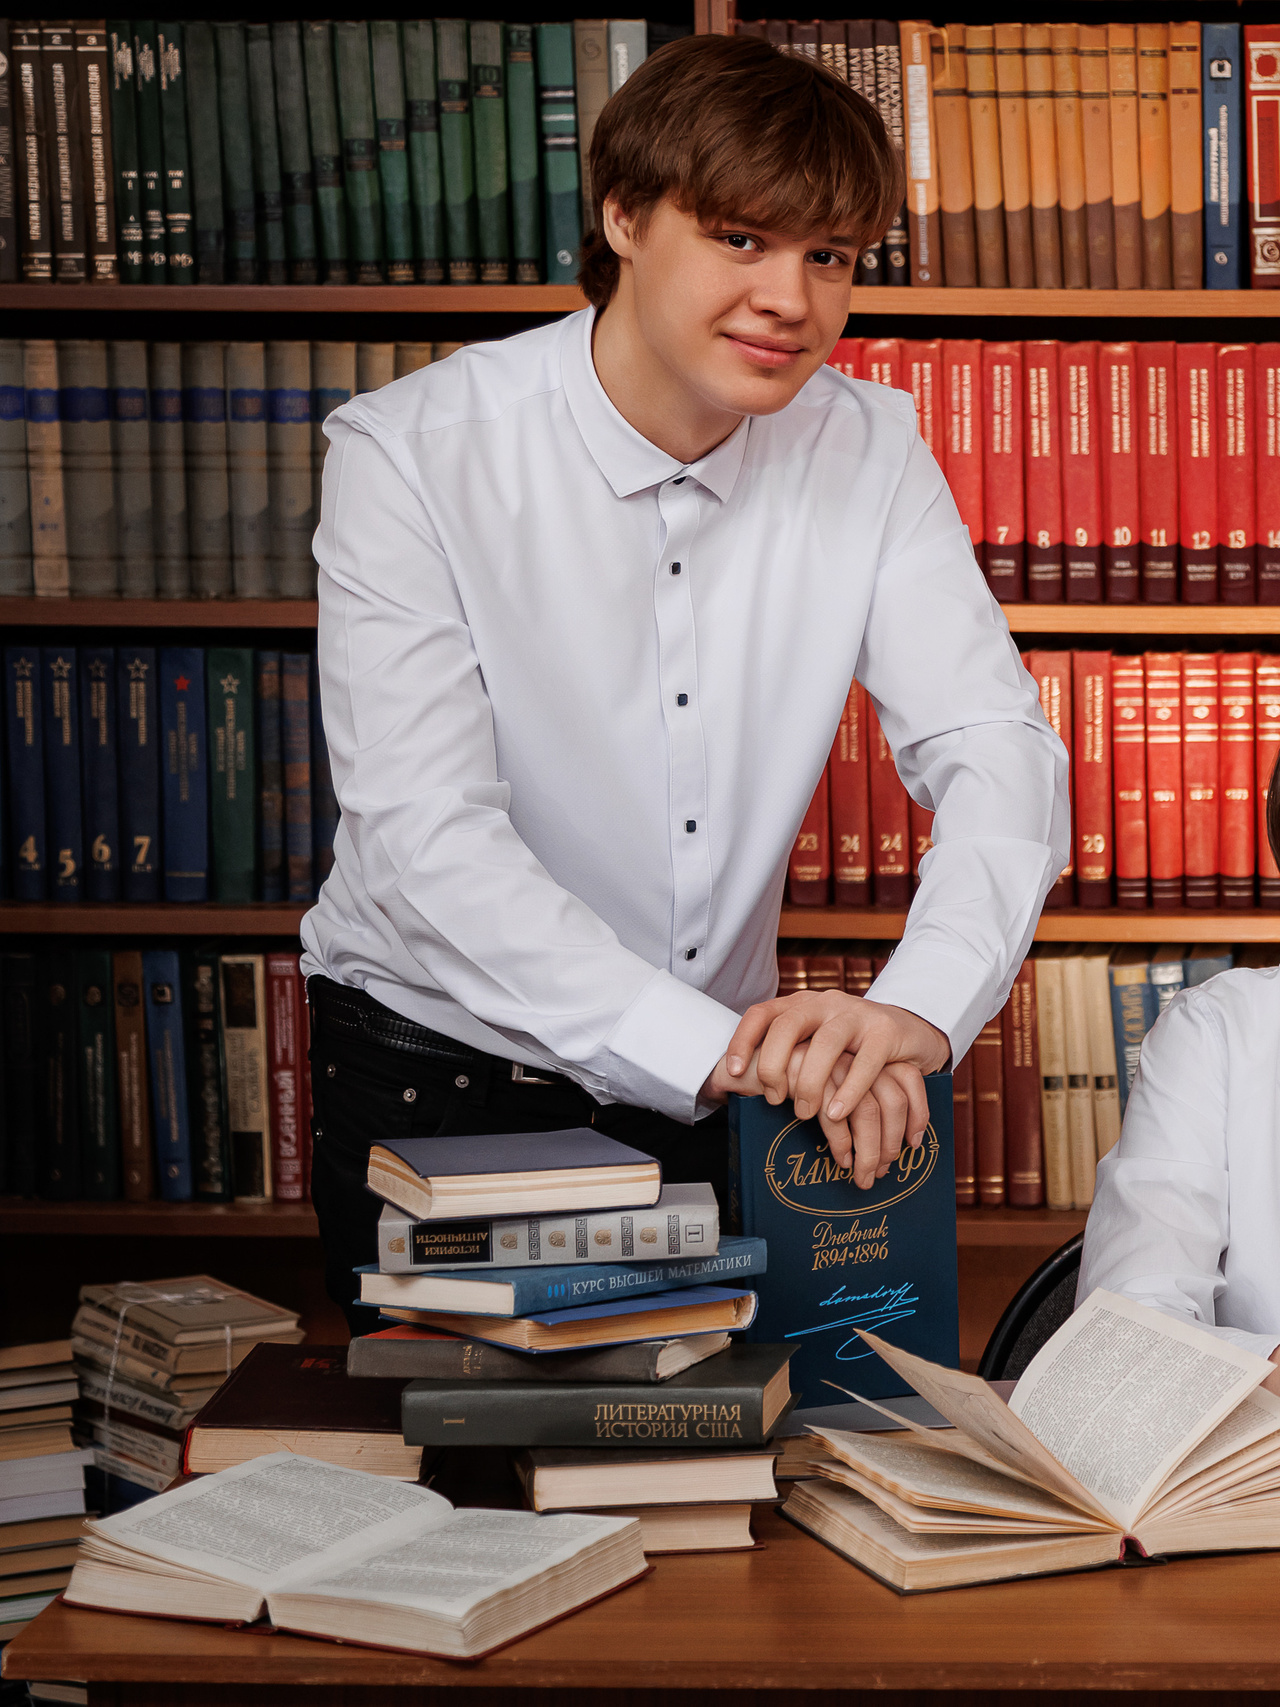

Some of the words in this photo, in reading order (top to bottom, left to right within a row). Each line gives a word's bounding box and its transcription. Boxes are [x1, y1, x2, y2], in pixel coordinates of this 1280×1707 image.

[52, 34, 63, 45] 2
[86, 35, 97, 45] 3
[997, 526, 1009, 543] 7
[1037, 530, 1050, 549] 8
[1075, 527, 1088, 547] 9
[1112, 526, 1132, 546] 10
[1150, 528, 1168, 547] 11
[1192, 530, 1211, 550] 12
[1228, 529, 1246, 549] 13
[19, 834, 38, 863] 4
[91, 833, 112, 863] 6
[133, 835, 151, 864] 7
[798, 833, 818, 851] 23
[840, 834, 860, 853] 24
[880, 832, 903, 852] 24
[58, 848, 77, 878] 5
[274, 1070, 297, 1157] ВОЕННЫЙ
[777, 1143, 926, 1189] ЛАМЗФ
[415, 1230, 489, 1245] АНТИЧНОСТИ
[811, 1215, 889, 1249] Дневник
[424, 1243, 480, 1256] ИСТОРИКИ
[571, 1278, 606, 1296] КУРС
[608, 1266, 665, 1291] ВЫСШЕЙ
[667, 1254, 752, 1280] МАТЕМАТИКИ
[594, 1403, 741, 1422] ЛИТЕРАТУРНАЯ
[596, 1421, 689, 1438] ИСТОРИЯ
[695, 1421, 743, 1439] США
